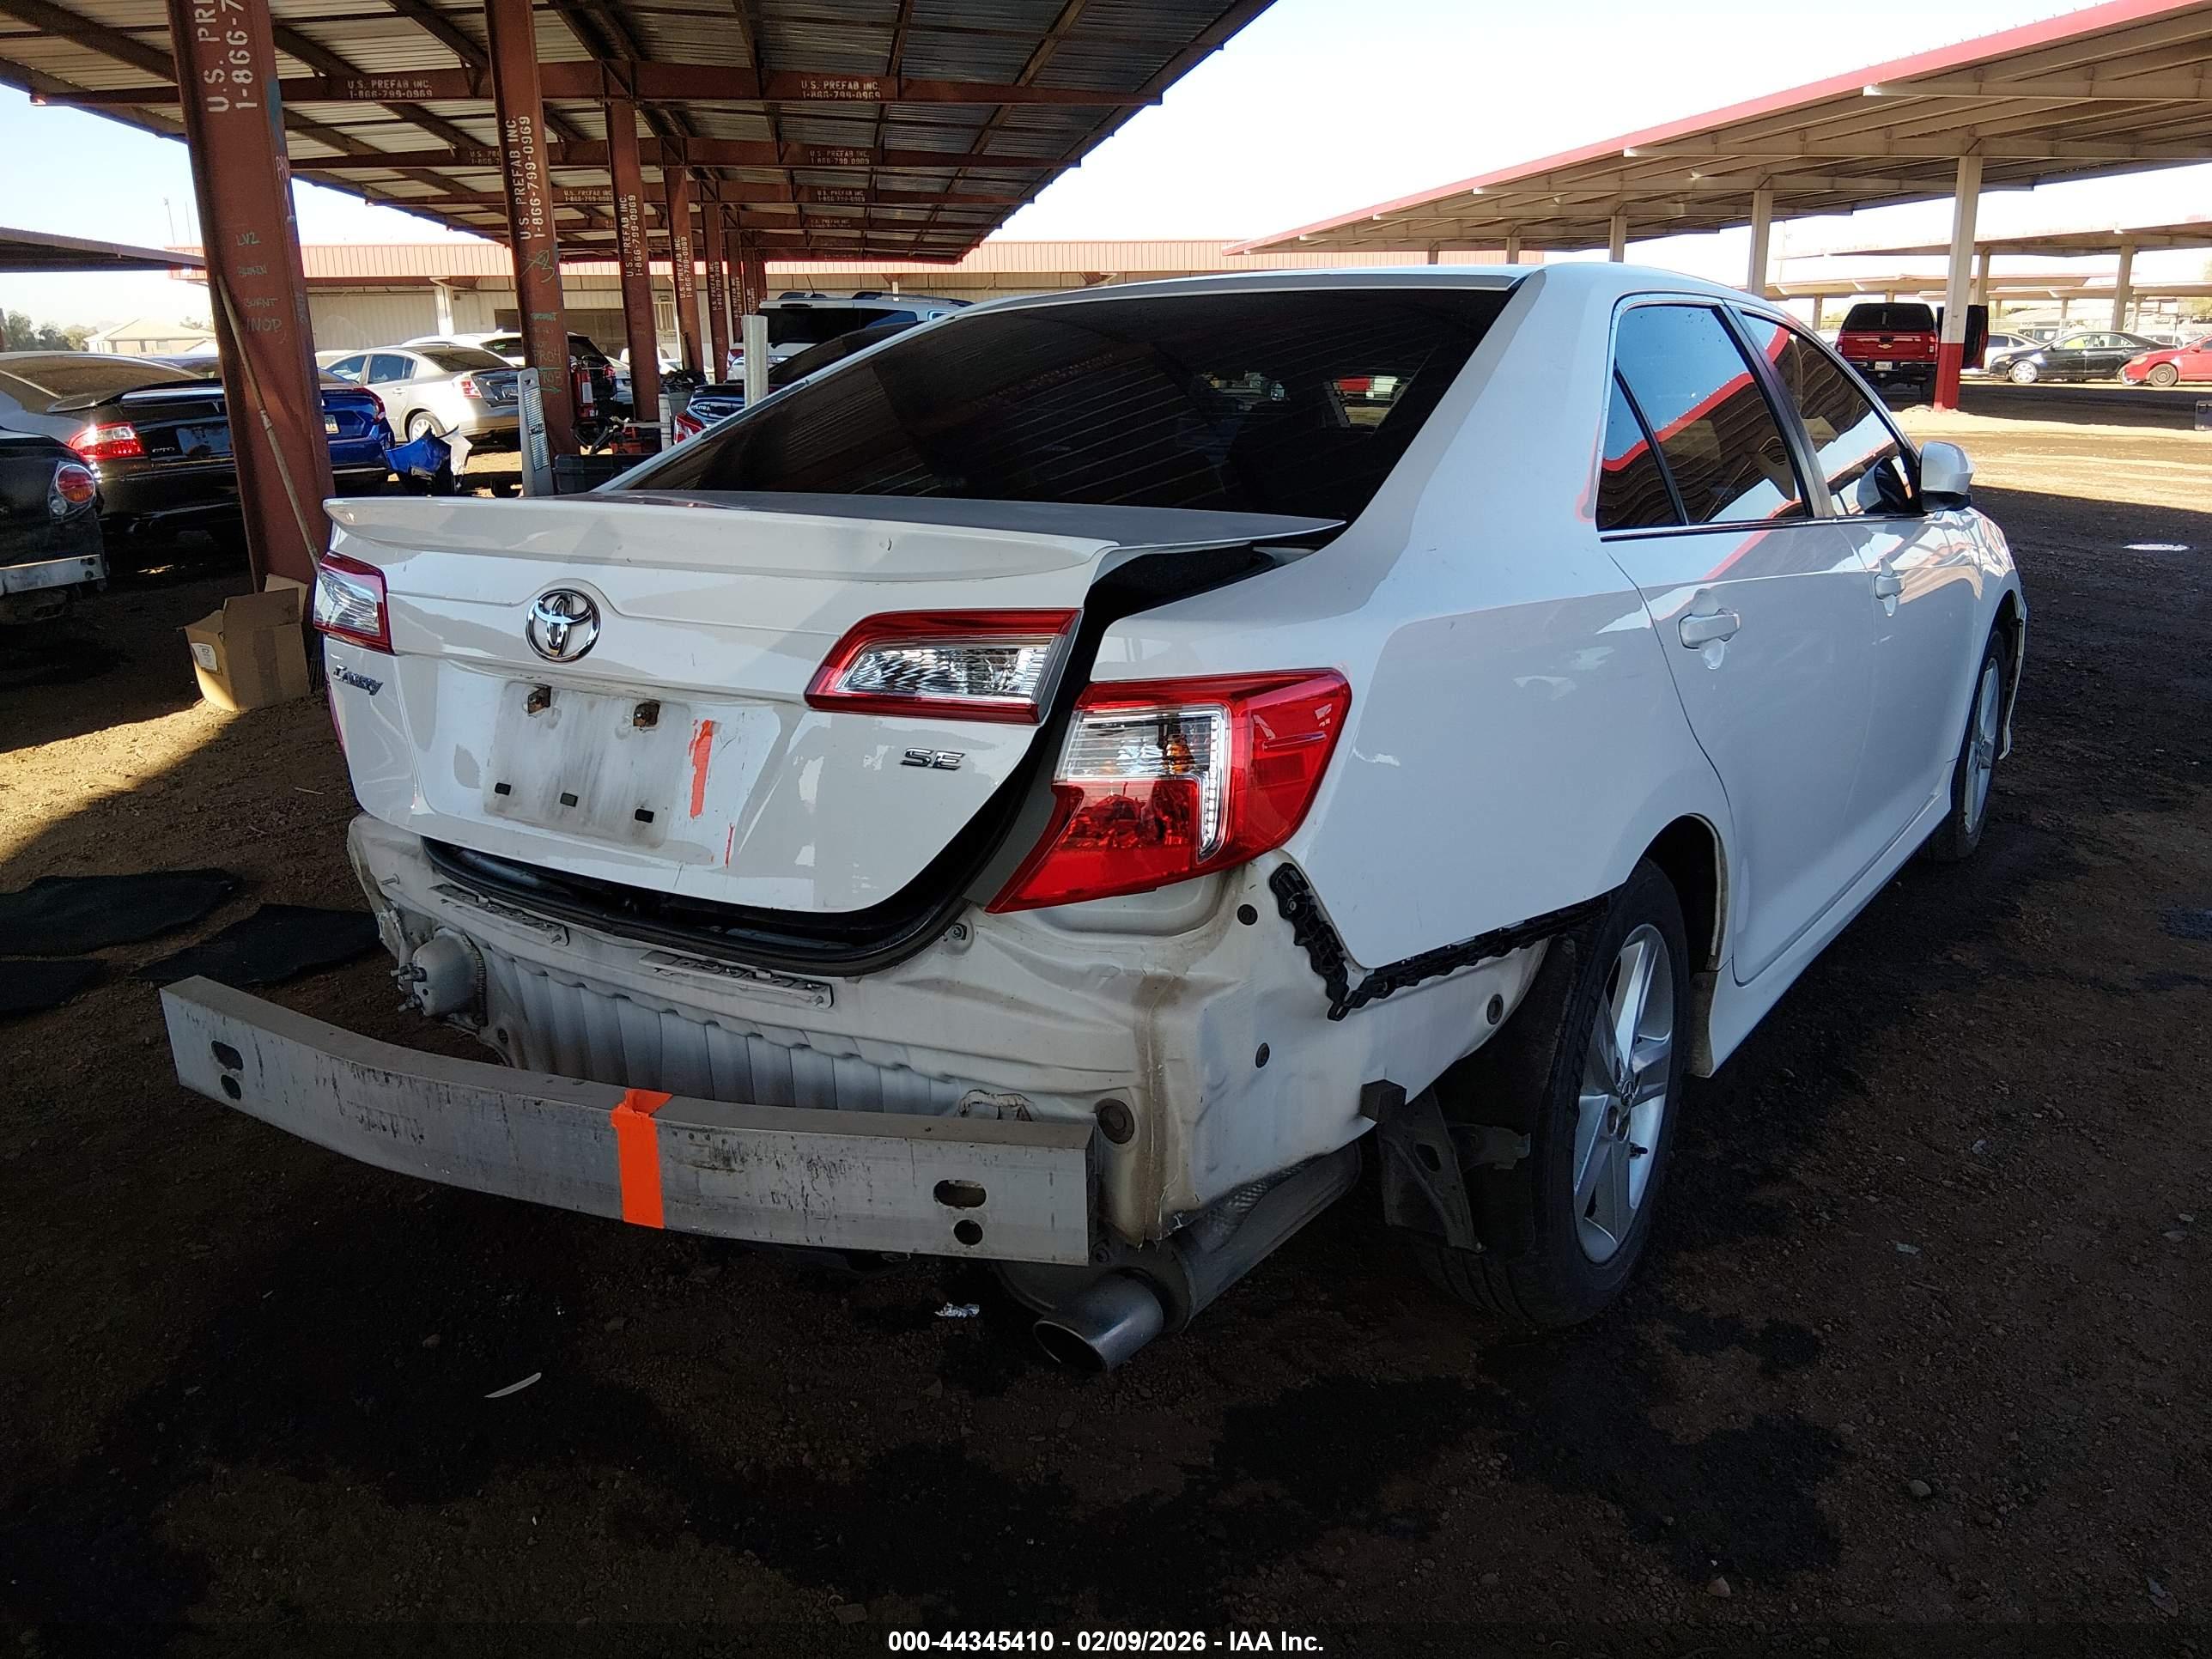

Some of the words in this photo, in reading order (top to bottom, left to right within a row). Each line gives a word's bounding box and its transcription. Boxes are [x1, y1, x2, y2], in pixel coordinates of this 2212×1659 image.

[193, 0, 220, 42] PR
[204, 60, 229, 112] U.S.
[347, 79, 367, 89] U.S.
[371, 79, 409, 89] PREFAB
[413, 80, 432, 88] INC.
[801, 80, 819, 89] U.S.
[823, 81, 860, 90] PREFAB
[863, 82, 881, 90] INC.
[505, 116, 520, 143] INC.
[509, 150, 528, 205] PREFAB
[519, 116, 545, 239] 1-866-799-0969
[618, 194, 629, 214] INC.
[519, 212, 532, 240] U.S.
[621, 216, 631, 255] PREFAB
[899, 747, 967, 771] SE
